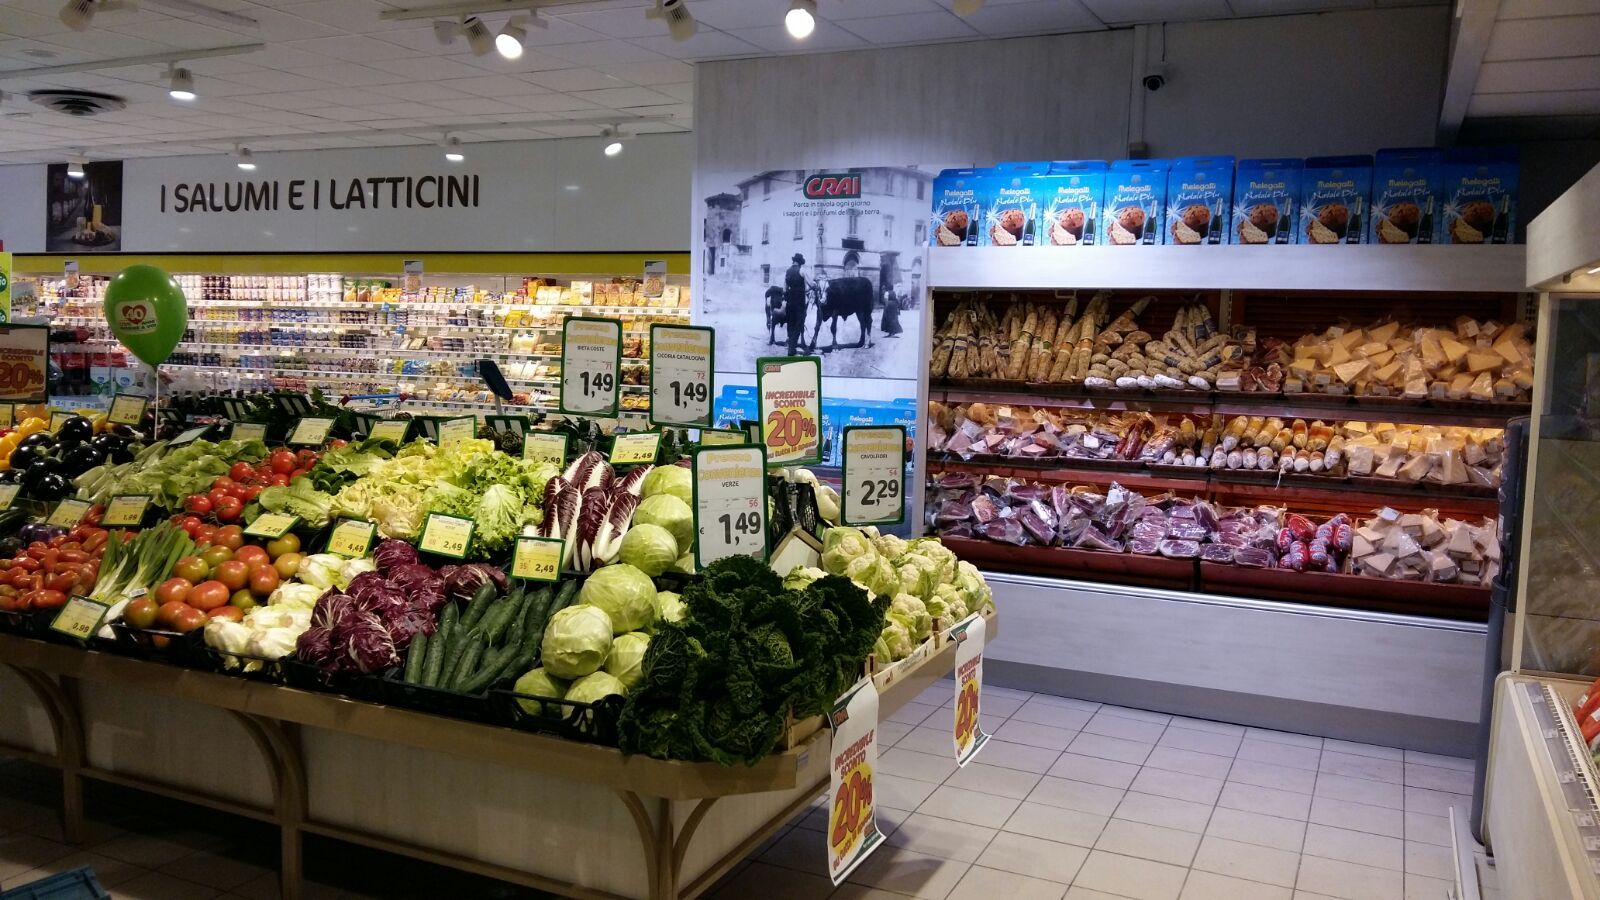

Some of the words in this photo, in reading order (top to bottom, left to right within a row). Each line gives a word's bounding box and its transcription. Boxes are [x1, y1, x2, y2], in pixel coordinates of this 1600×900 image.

[806, 176, 859, 196] CRAI
[1182, 182, 1216, 191] Melegatti
[1250, 181, 1285, 191] Melegatti
[1317, 180, 1354, 189] Melegatti
[1388, 179, 1426, 188] Melegatti
[1462, 177, 1501, 187] Melegatti
[160, 184, 166, 213] I
[174, 181, 278, 213] SALUMI
[288, 180, 305, 211] E
[313, 179, 319, 210] I
[329, 174, 479, 210] LATTICINI
[1000, 188, 1031, 196] Melegatti
[1057, 187, 1090, 195] Melegatti
[1118, 185, 1151, 193] Melegatti
[944, 190, 974, 199] Melegatti
[126, 308, 144, 320] 40
[580, 371, 614, 398] 1,49
[670, 381, 707, 408] 1,49
[765, 391, 815, 399] INCREDIBILE
[774, 400, 806, 408] SCONTO
[767, 410, 816, 447] 20%
[633, 452, 652, 460] 2,49
[860, 479, 899, 506] 2,29
[748, 499, 758, 508] 56
[700, 527, 704, 535] €
[718, 511, 761, 546] 1,49
[348, 543, 364, 552] 4,49
[443, 541, 463, 551] 2,49
[535, 563, 554, 573] 2,49
[72, 622, 90, 633] 0,99
[834, 729, 874, 771] INCREDIBILE
[840, 750, 866, 780] SCONTO
[832, 771, 873, 848] 20%
